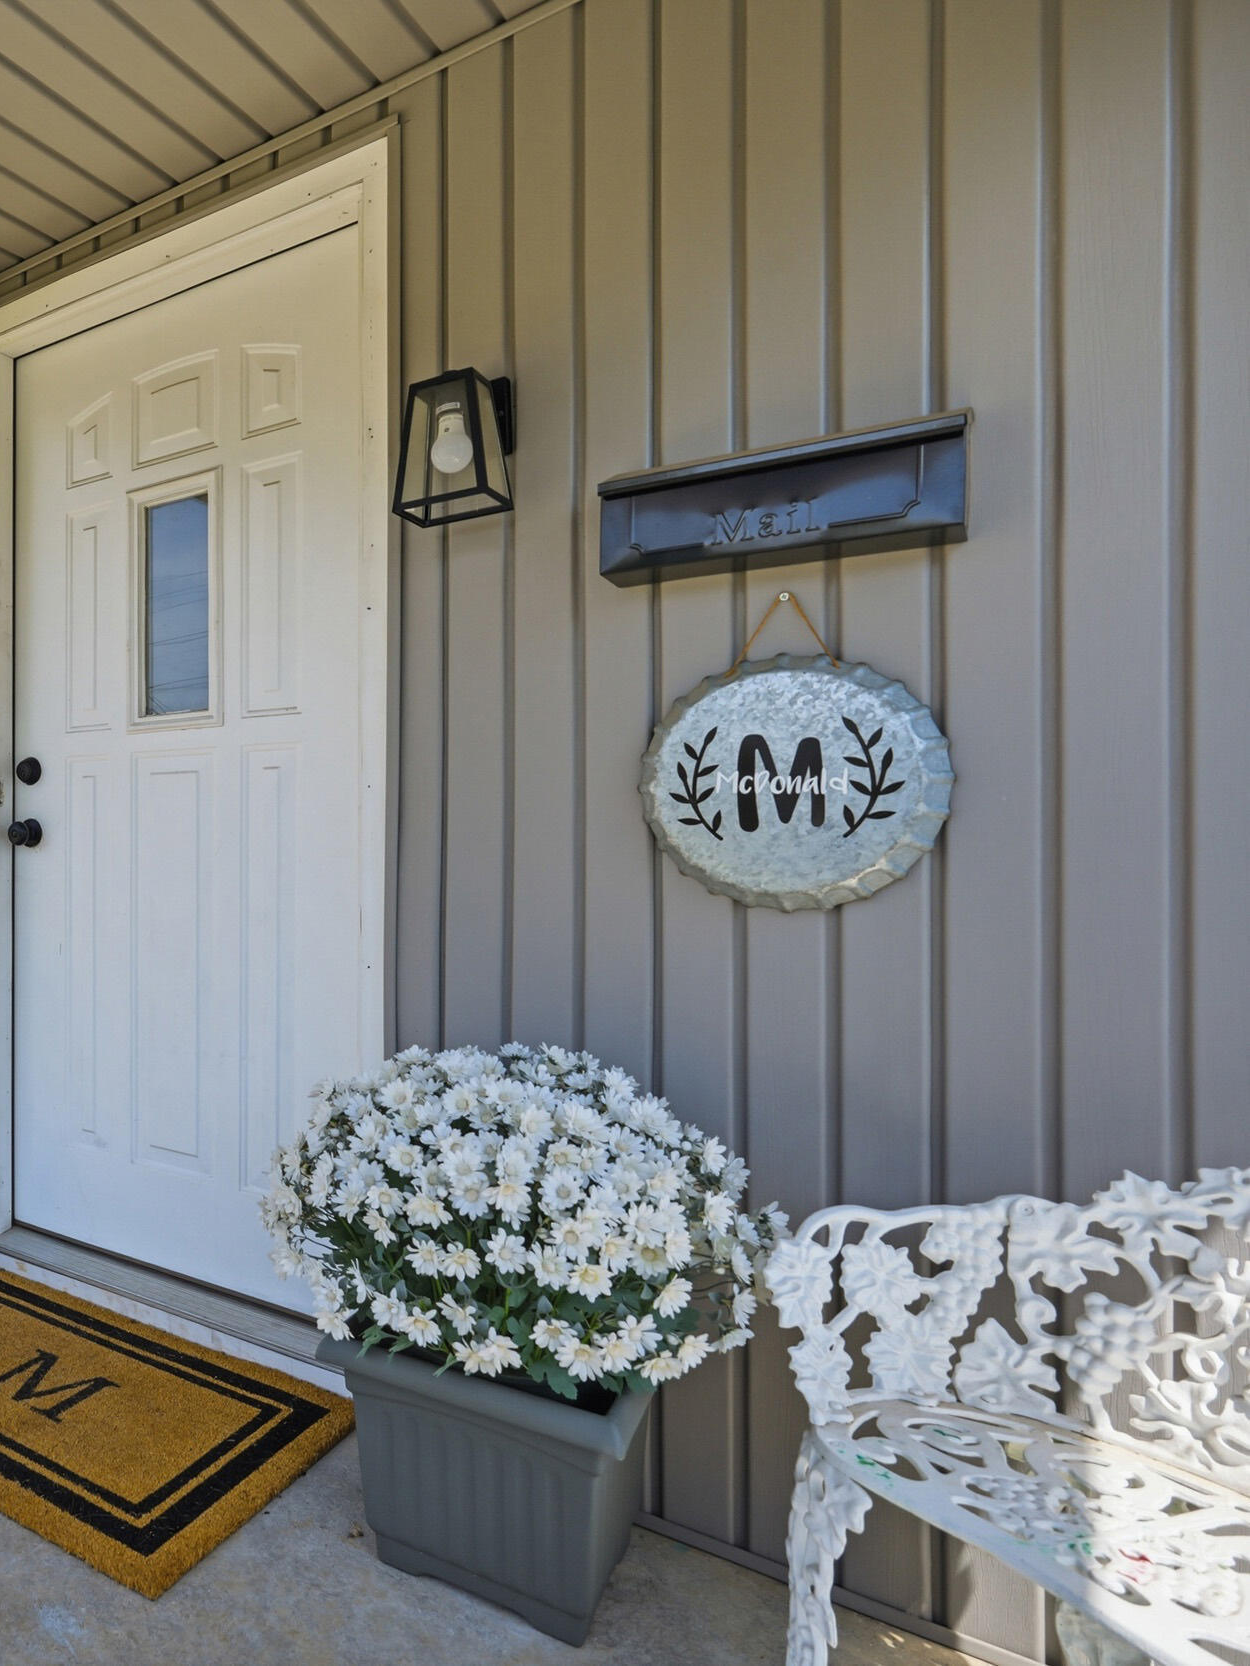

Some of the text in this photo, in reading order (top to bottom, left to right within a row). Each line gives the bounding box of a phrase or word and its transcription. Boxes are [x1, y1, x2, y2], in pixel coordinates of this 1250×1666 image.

[710, 498, 822, 546] Mail
[715, 767, 851, 795] McDonald
[736, 733, 826, 832] M
